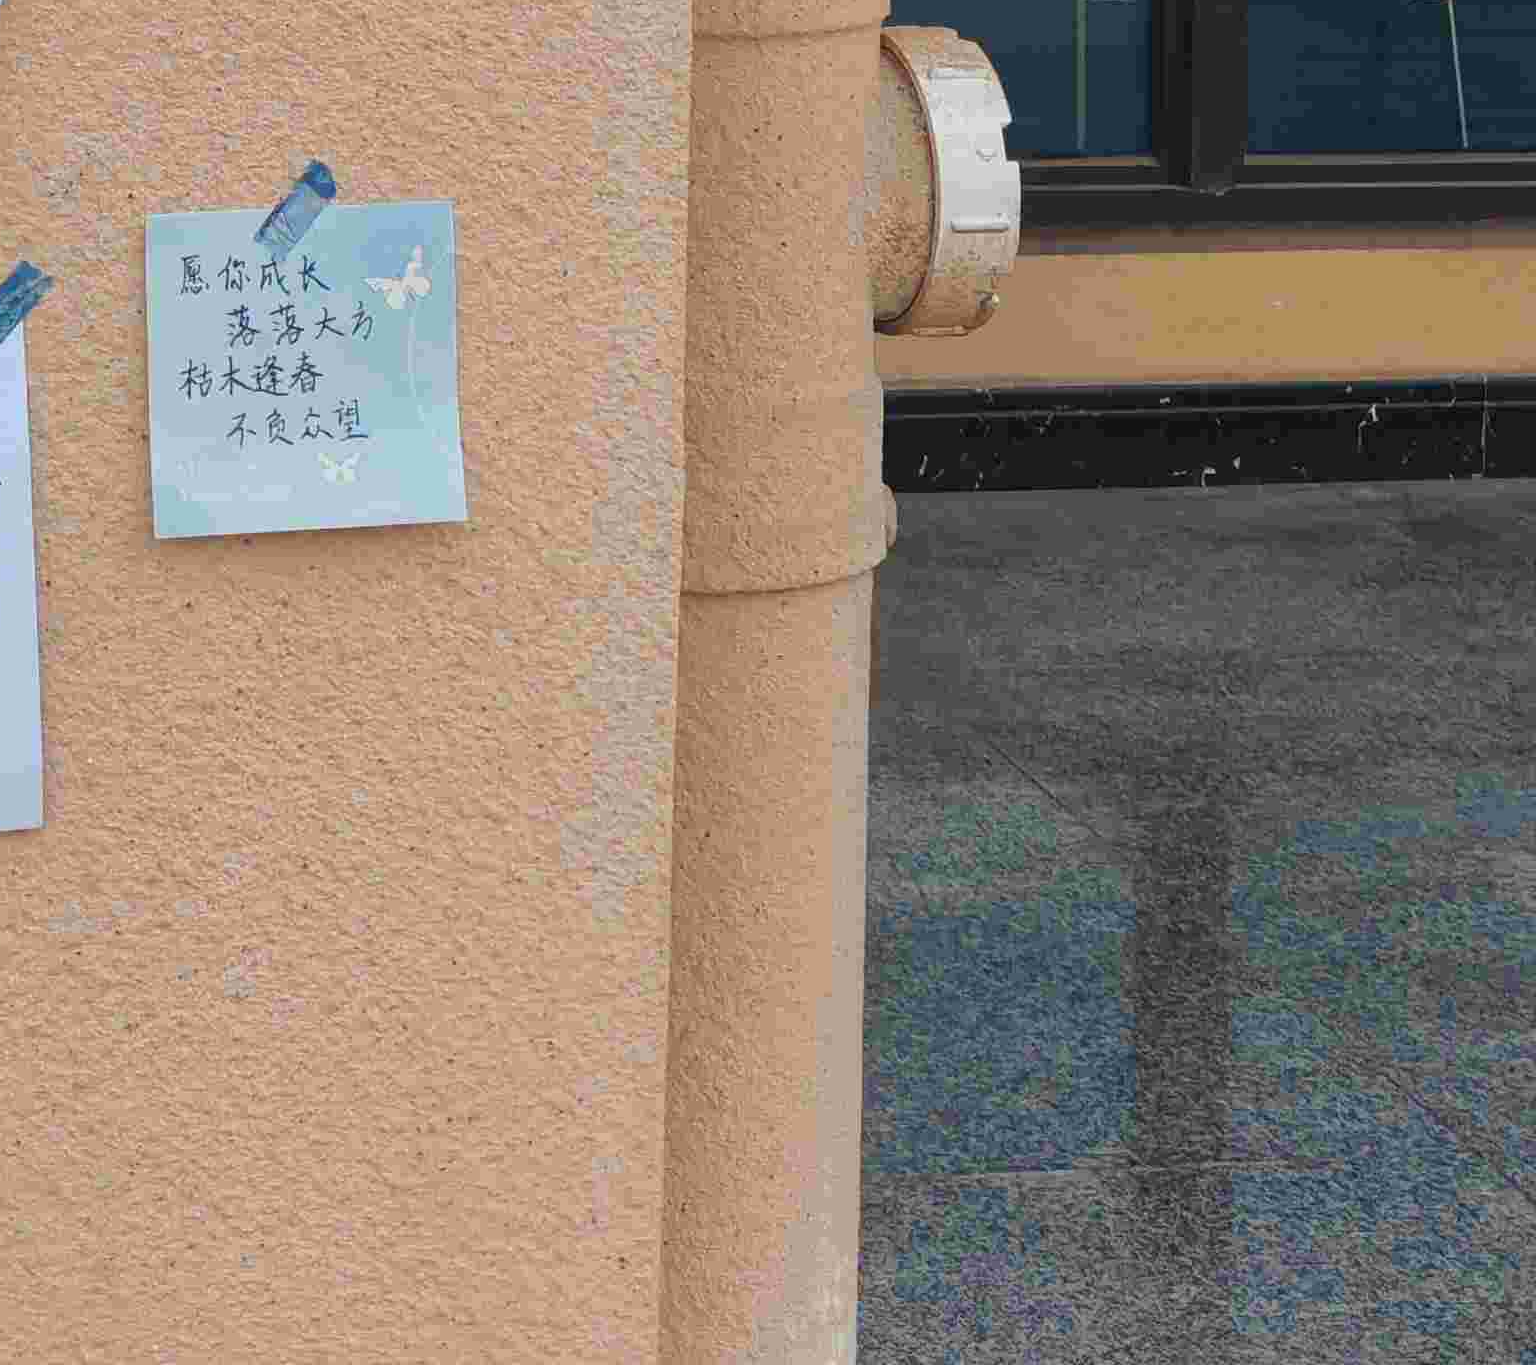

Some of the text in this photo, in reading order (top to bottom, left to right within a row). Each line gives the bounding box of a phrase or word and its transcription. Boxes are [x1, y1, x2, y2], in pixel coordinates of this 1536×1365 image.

[178, 253, 332, 296] 愿你成长
[226, 300, 377, 349] 落落大方
[178, 350, 325, 401] 枯木逢春
[226, 398, 370, 449] 不负众望
